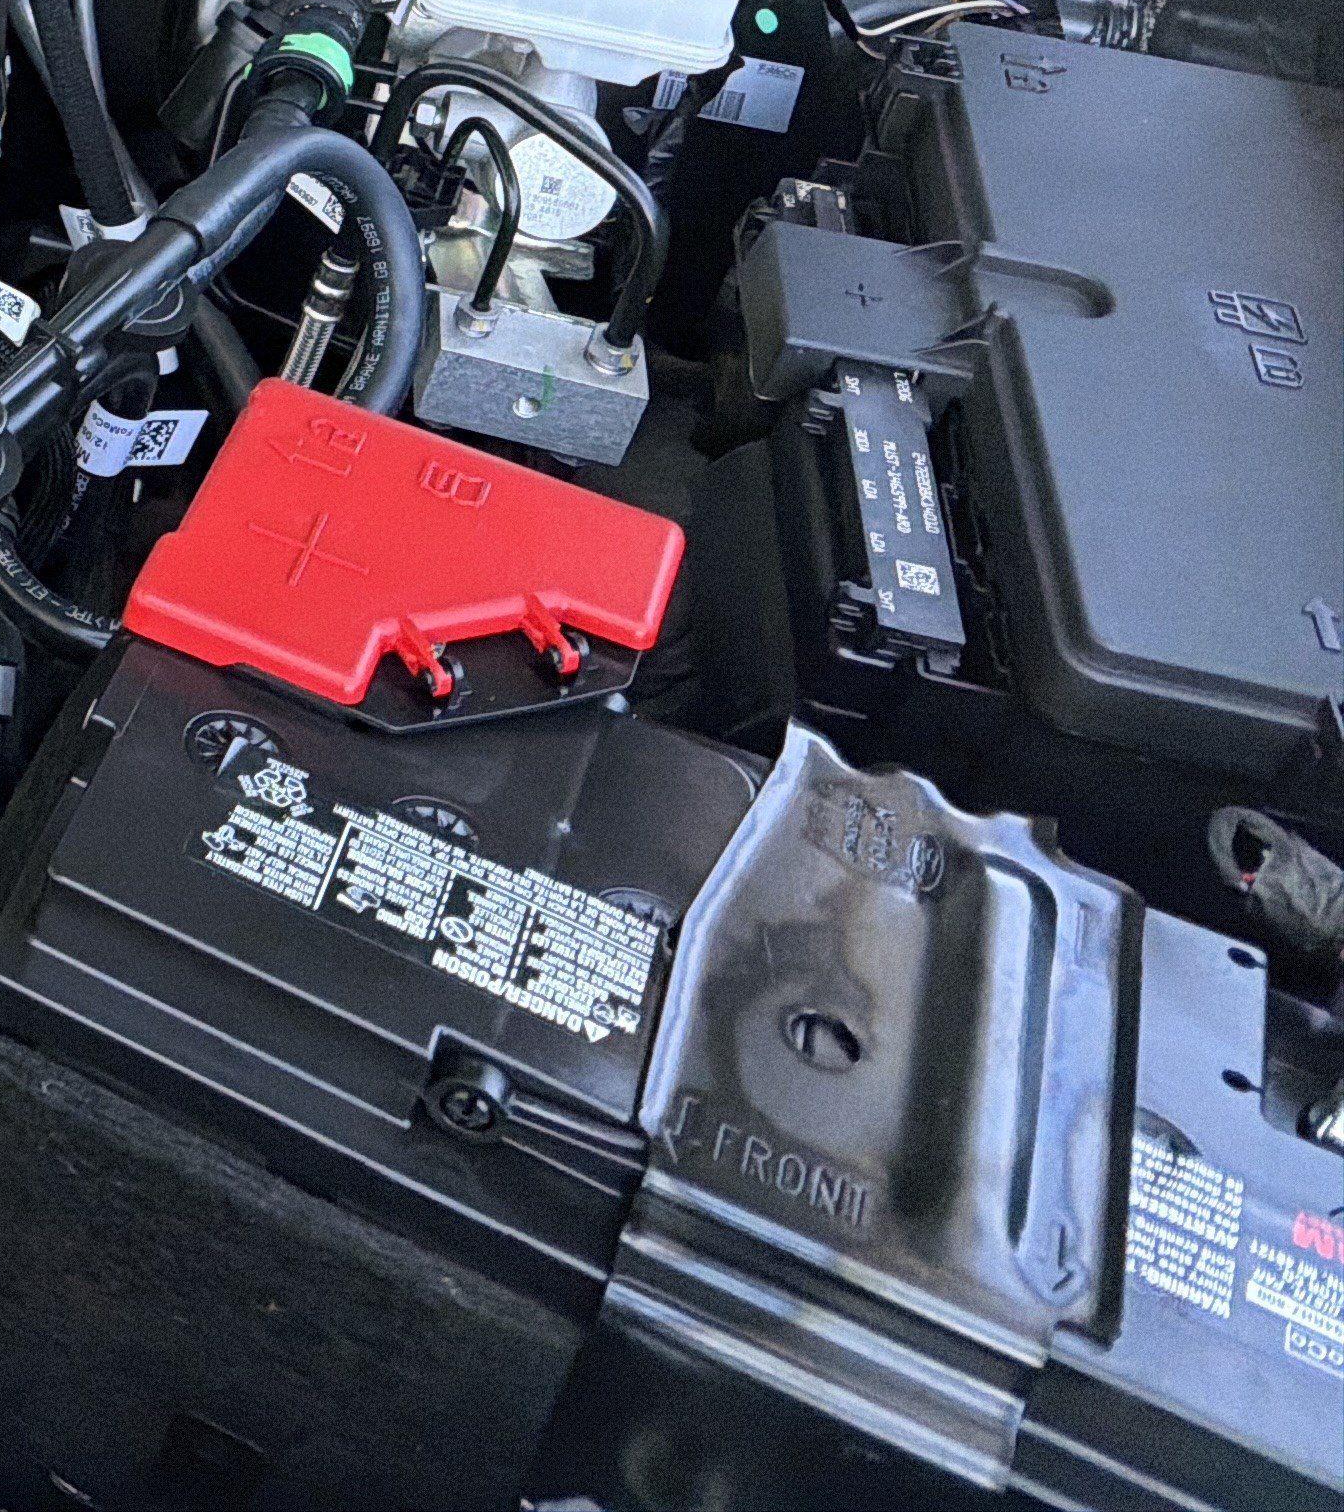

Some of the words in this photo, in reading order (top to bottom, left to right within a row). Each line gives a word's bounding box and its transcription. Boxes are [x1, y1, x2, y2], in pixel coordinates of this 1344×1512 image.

[372, 260, 389, 279] GB
[371, 285, 395, 347] ARNITEL
[349, 349, 379, 391] BRAKE
[853, 427, 870, 453] 300A
[861, 478, 878, 500] 60A
[869, 531, 886, 553] 60A
[333, 805, 374, 829] BATTERY!
[375, 822, 399, 840] OPEN
[398, 834, 417, 848] NOT
[255, 836, 278, 852] YEUX
[284, 828, 333, 856] CONSULTEZ
[358, 831, 390, 852] GRAVES
[432, 838, 452, 853] PAS
[205, 851, 262, 883] IMMEDIATELY
[265, 856, 286, 870] HELP
[347, 848, 404, 881] SULFURIQUE
[395, 859, 425, 878] CAUSER
[451, 857, 470, 871] NOT
[262, 876, 284, 893] EYES
[287, 864, 320, 886] MEDICAL
[336, 868, 385, 896] BLINDNESS
[354, 865, 386, 886] BURNS
[424, 873, 445, 887] PEUT
[512, 873, 532, 889] DES
[283, 886, 313, 906] FLUSH
[293, 879, 316, 896] WITH
[387, 880, 422, 902] SEVERE
[385, 890, 414, 909] CAUSE
[485, 889, 511, 907] FUMER
[586, 896, 623, 919] OUVRIR
[404, 909, 430, 928] ACID
[414, 903, 434, 918] CAN
[546, 901, 577, 920] REACH
[376, 908, 427, 939] SULFURIC
[578, 914, 595, 929] THE
[599, 912, 627, 932] HORS
[624, 913, 644, 929] PAS
[475, 931, 513, 955] SMOKING
[543, 928, 580, 950] PEUVENT
[610, 930, 630, 945] OUT
[627, 927, 655, 946] TENIR
[546, 940, 576, 960] YEUX
[580, 943, 626, 970] EXPLOSIFS
[630, 940, 654, 956] KEEP
[526, 956, 555, 976] CAUSE
[624, 964, 648, 982] GAZ
[556, 970, 576, 985] CAN
[432, 949, 583, 1032] DANGER/POISON
[527, 979, 555, 999] EYES
[538, 972, 595, 1006] EXPLOSIVE
[576, 978, 609, 1001] GASES
[591, 974, 642, 1005] BLINDNESS
[554, 991, 591, 1016] SHIELD
